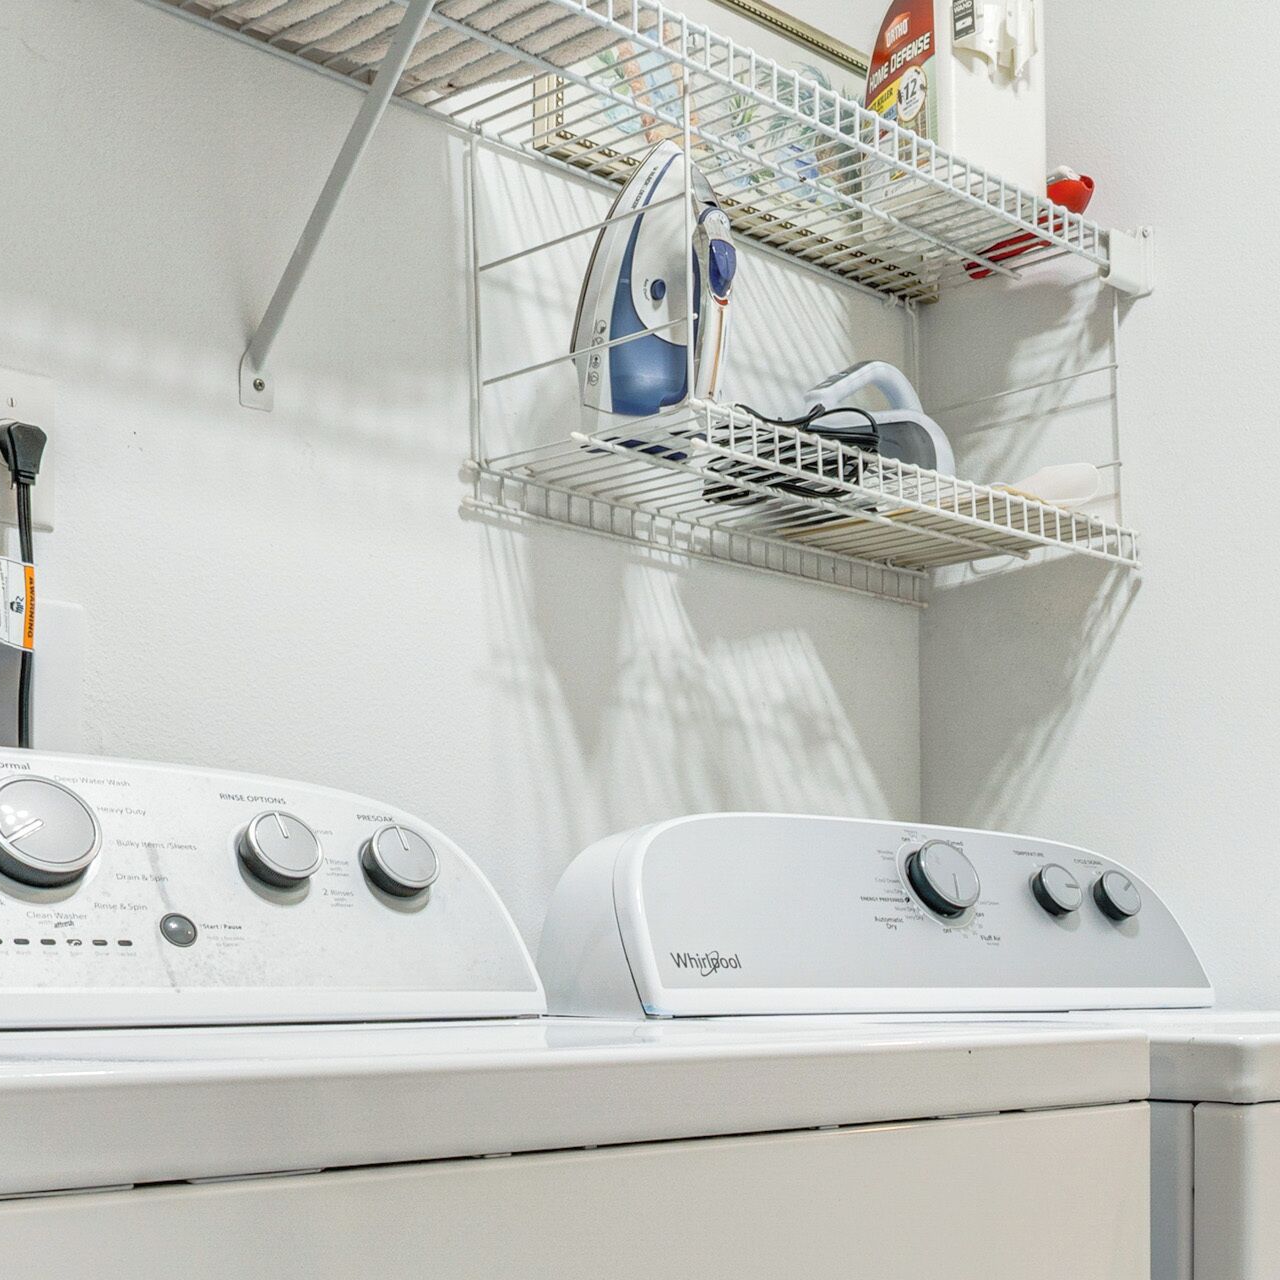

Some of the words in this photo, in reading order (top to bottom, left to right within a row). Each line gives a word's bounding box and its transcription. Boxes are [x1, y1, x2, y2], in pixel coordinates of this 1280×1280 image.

[886, 17, 910, 49] ORTHO
[869, 61, 890, 94] HOME
[890, 31, 932, 75] DEFENSE
[903, 78, 918, 101] 12
[80, 776, 106, 786] Water
[107, 778, 131, 787] Wash
[219, 793, 245, 803] RINSE
[246, 795, 287, 805] OPTIONS
[96, 805, 124, 815] Heavy
[124, 807, 147, 816] Duty
[356, 813, 397, 823] PRESOAK
[115, 838, 140, 849] Bulky
[116, 872, 141, 882] Drain
[149, 873, 169, 883] Spin
[93, 902, 118, 911] Rinse
[128, 903, 148, 913] Spin
[26, 910, 53, 920] Clean
[54, 911, 87, 921] Washer
[669, 950, 742, 974] Whirlpool
